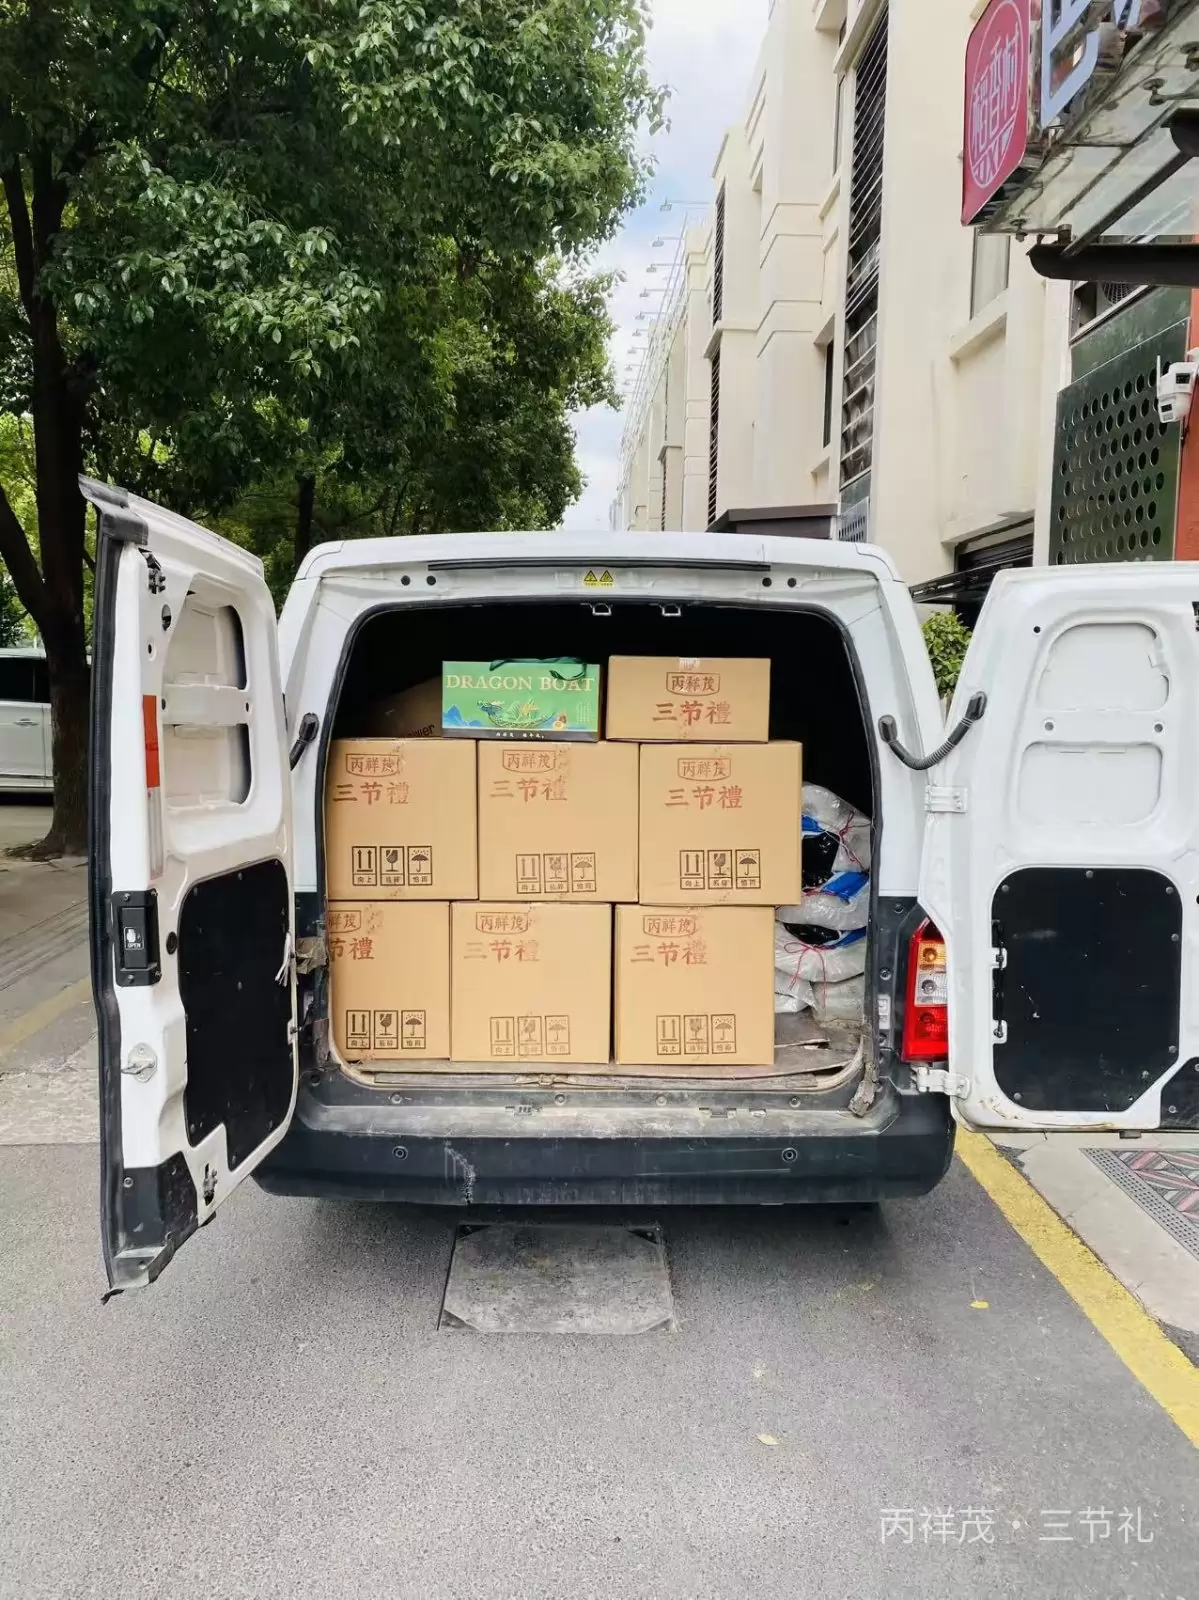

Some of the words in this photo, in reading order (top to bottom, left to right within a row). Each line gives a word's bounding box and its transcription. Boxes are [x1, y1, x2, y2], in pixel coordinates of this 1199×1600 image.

[446, 674, 532, 690] DRAGON
[540, 676, 594, 692] BOAT
[671, 675, 715, 692] 丙祥茂
[652, 700, 732, 726] 三节禮
[506, 752, 551, 769] 丙祥茂
[682, 761, 727, 777] 丙祥茂
[332, 781, 410, 806] 三节禮
[489, 776, 569, 803] 三节禮
[664, 785, 743, 810] 三节禮
